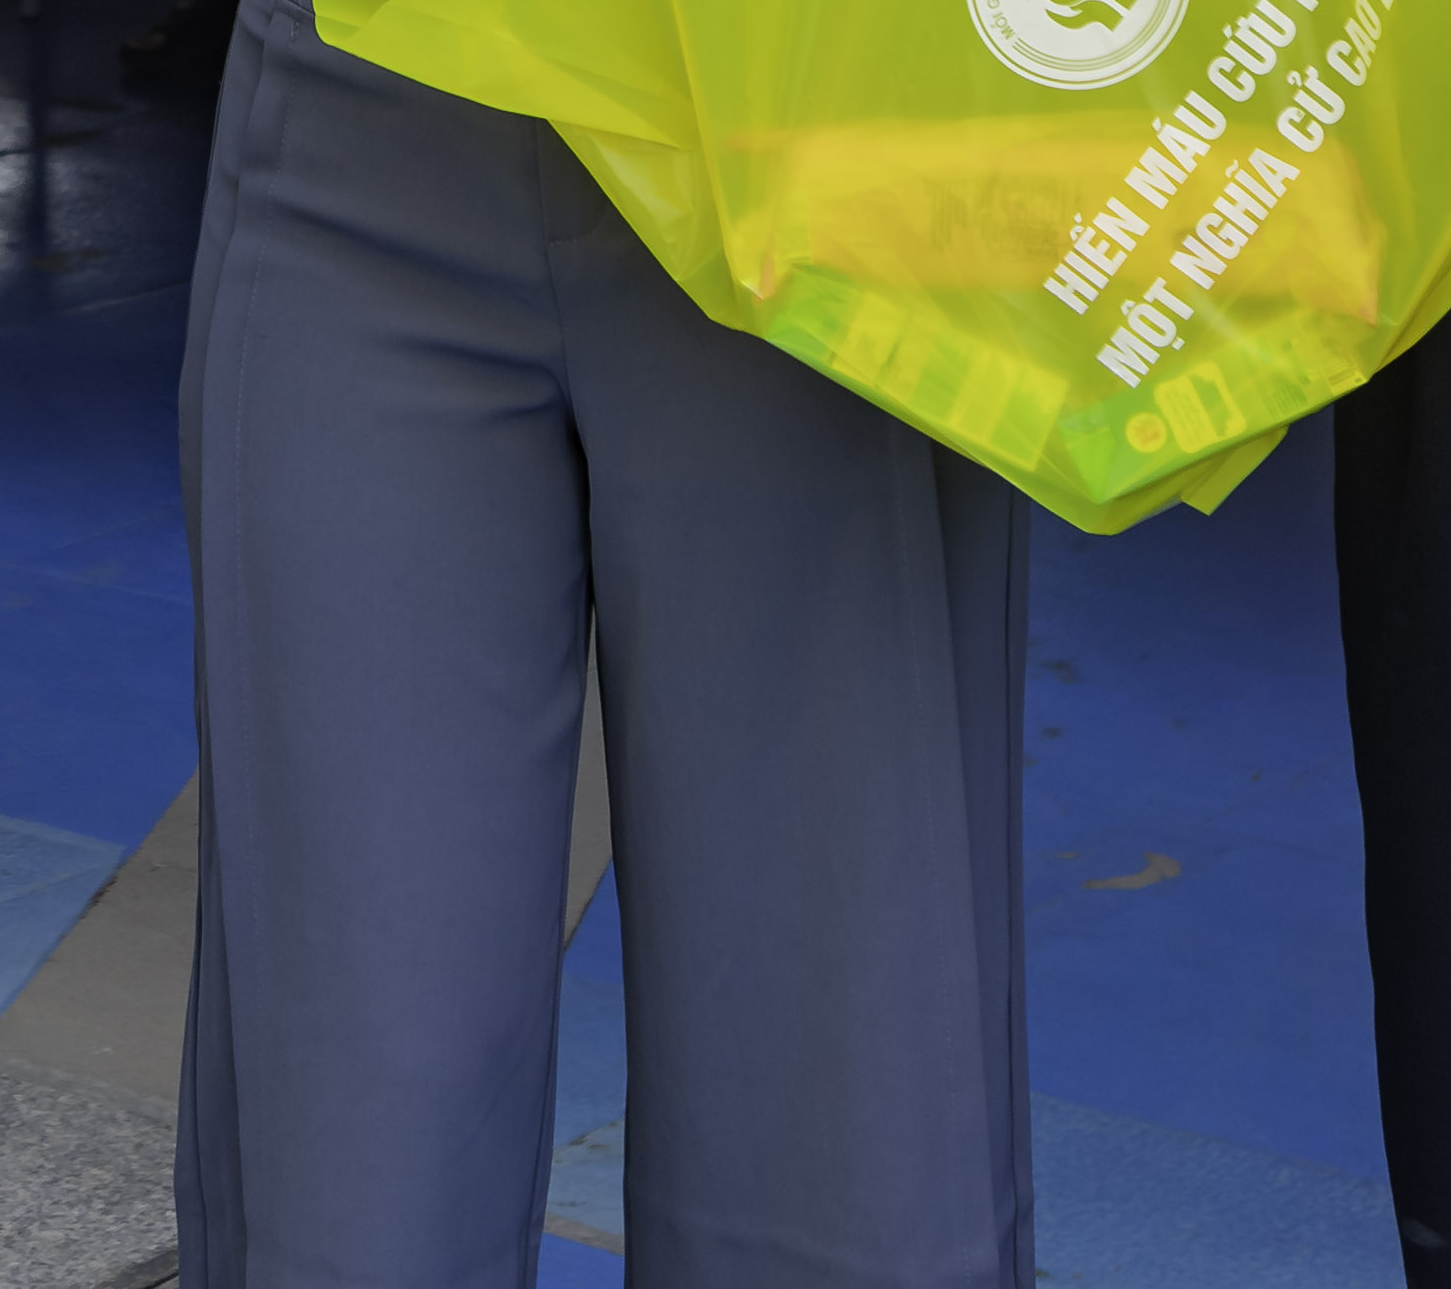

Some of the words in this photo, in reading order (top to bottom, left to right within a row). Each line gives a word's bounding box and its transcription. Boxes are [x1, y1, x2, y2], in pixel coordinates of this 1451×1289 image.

[990, 11, 1016, 41] MỖI
[1043, 197, 1150, 316] HIẾN
[1124, 89, 1227, 210] MÁU
[1096, 277, 1194, 389] MỘT
[1169, 147, 1300, 290] NGHĨA
[1276, 65, 1346, 153] CỬ
